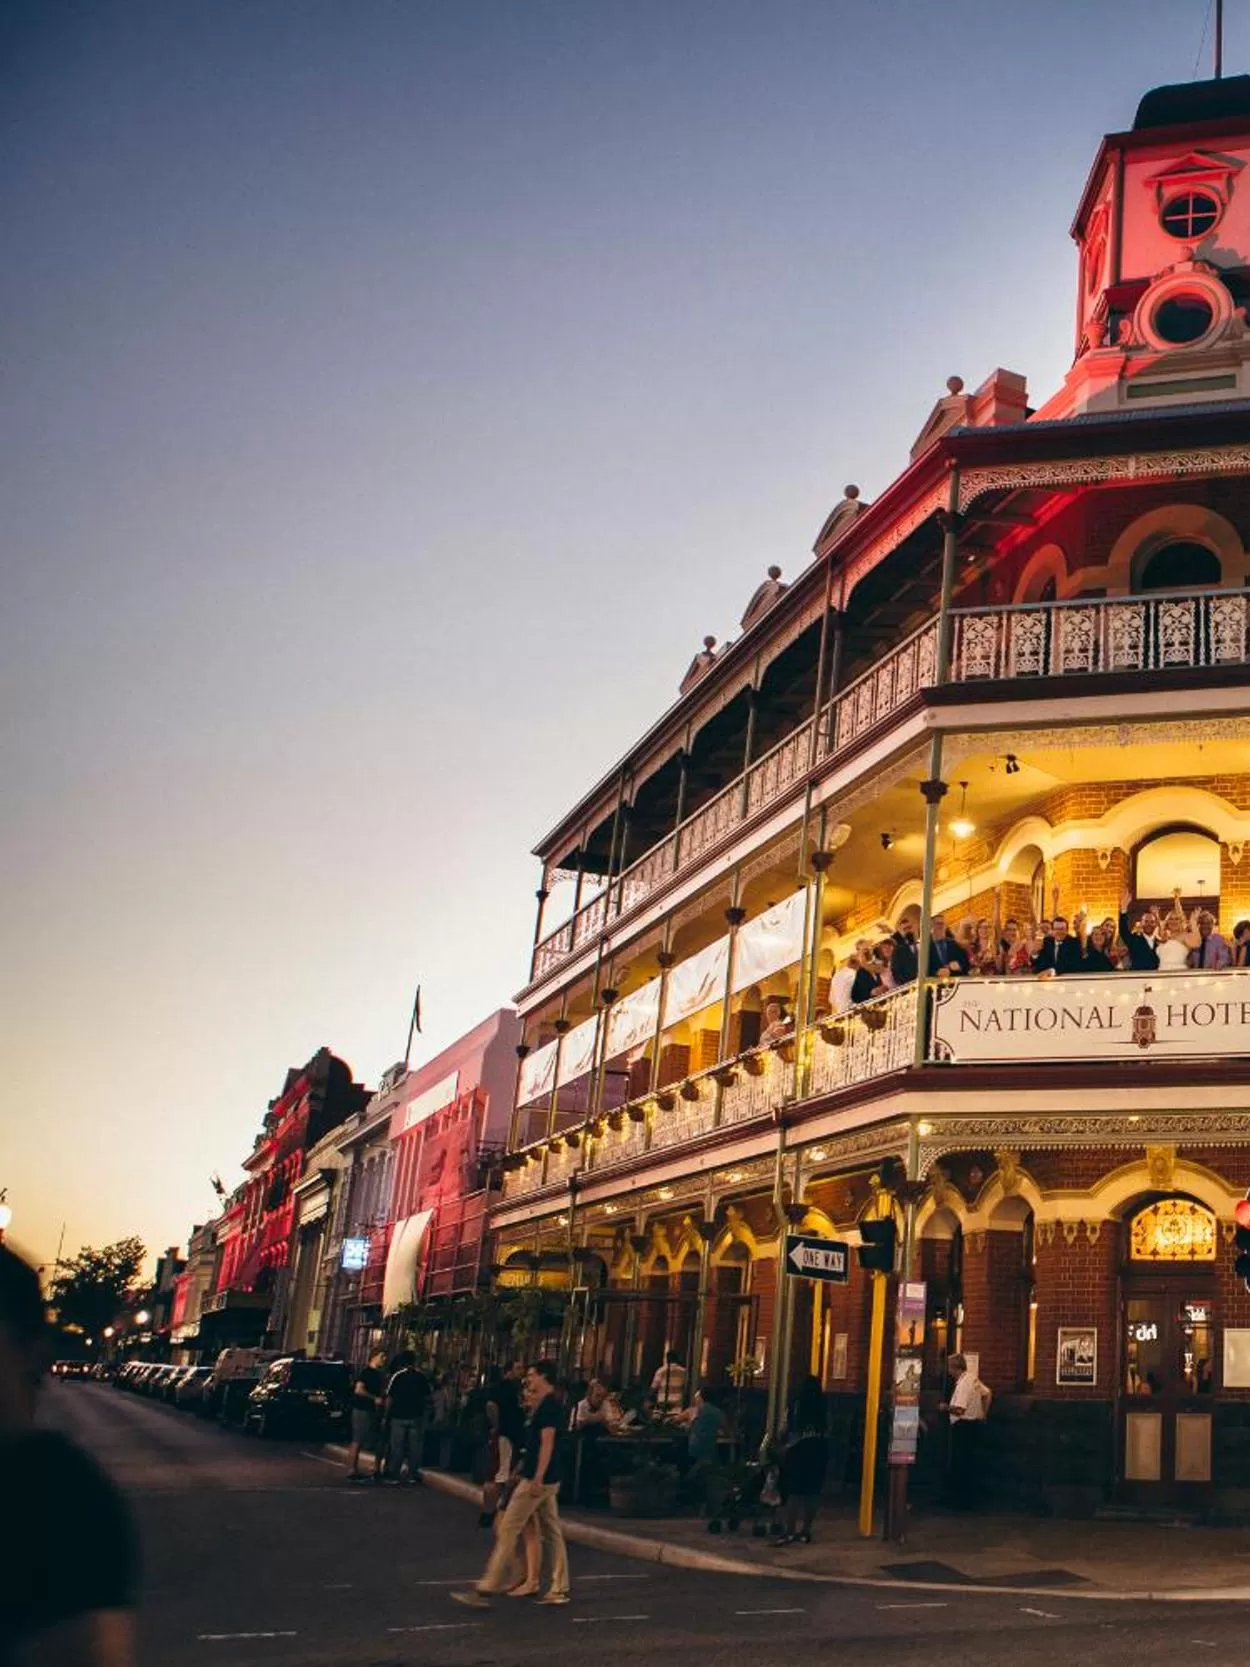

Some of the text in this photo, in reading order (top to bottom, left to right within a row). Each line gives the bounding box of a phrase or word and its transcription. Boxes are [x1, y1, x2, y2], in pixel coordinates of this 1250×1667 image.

[959, 1005, 1123, 1032] NATIONAL
[803, 1250, 843, 1269] ONE WAY
